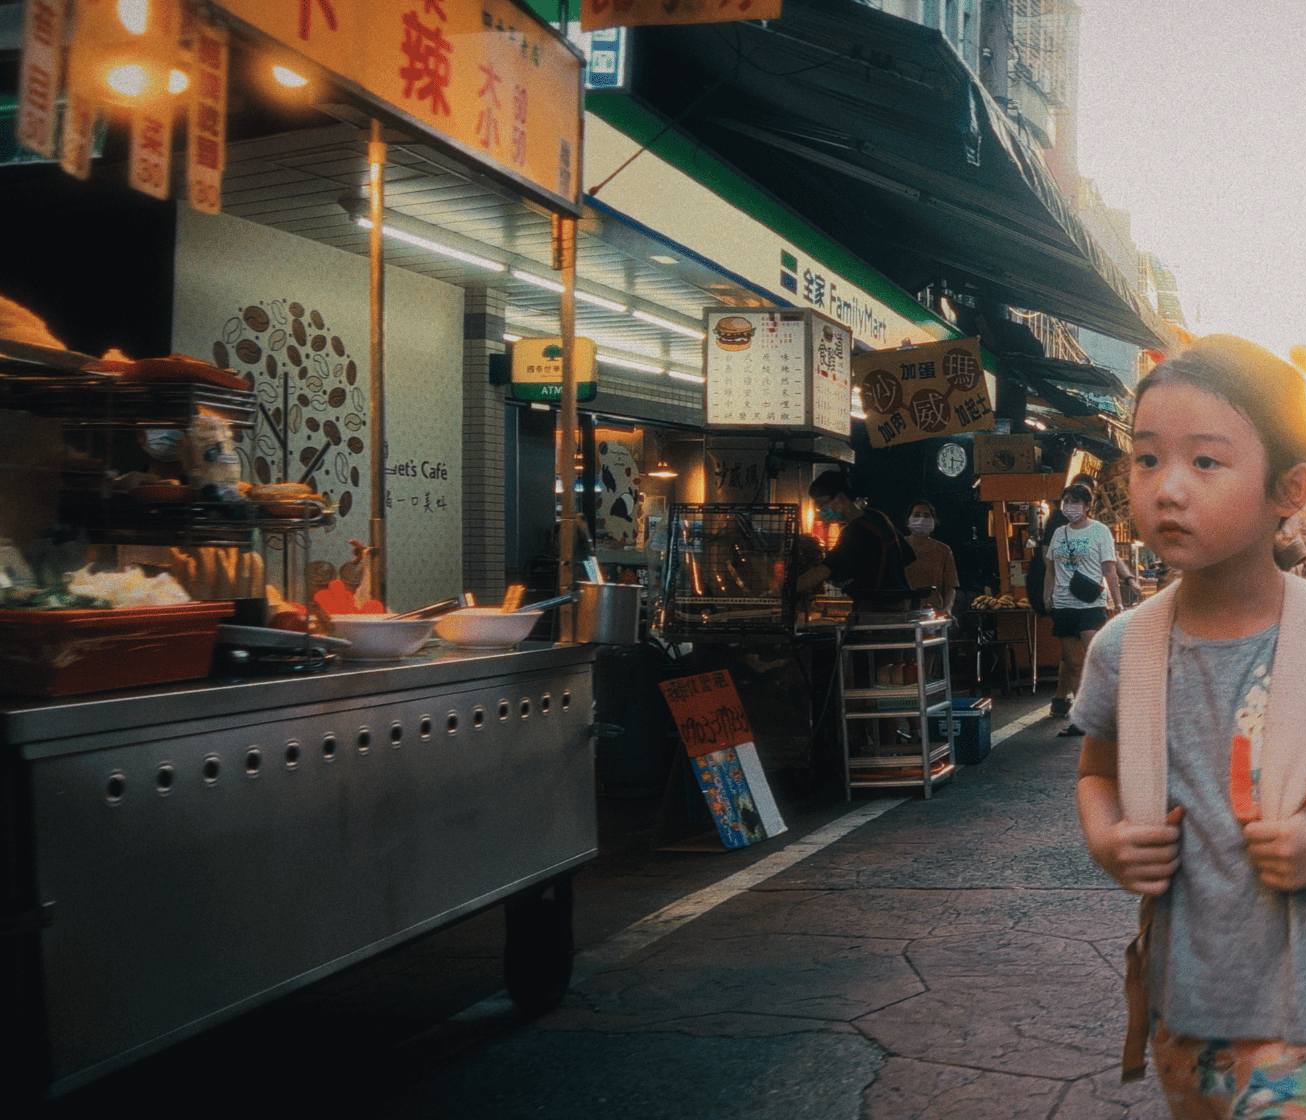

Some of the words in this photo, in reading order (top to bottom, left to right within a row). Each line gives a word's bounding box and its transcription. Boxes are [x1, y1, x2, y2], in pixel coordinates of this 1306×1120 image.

[803, 268, 825, 309] 全家
[830, 282, 887, 344] FamilyMart
[900, 361, 937, 380] 加蛋
[877, 411, 907, 443] 加肉
[421, 461, 448, 480] Café
